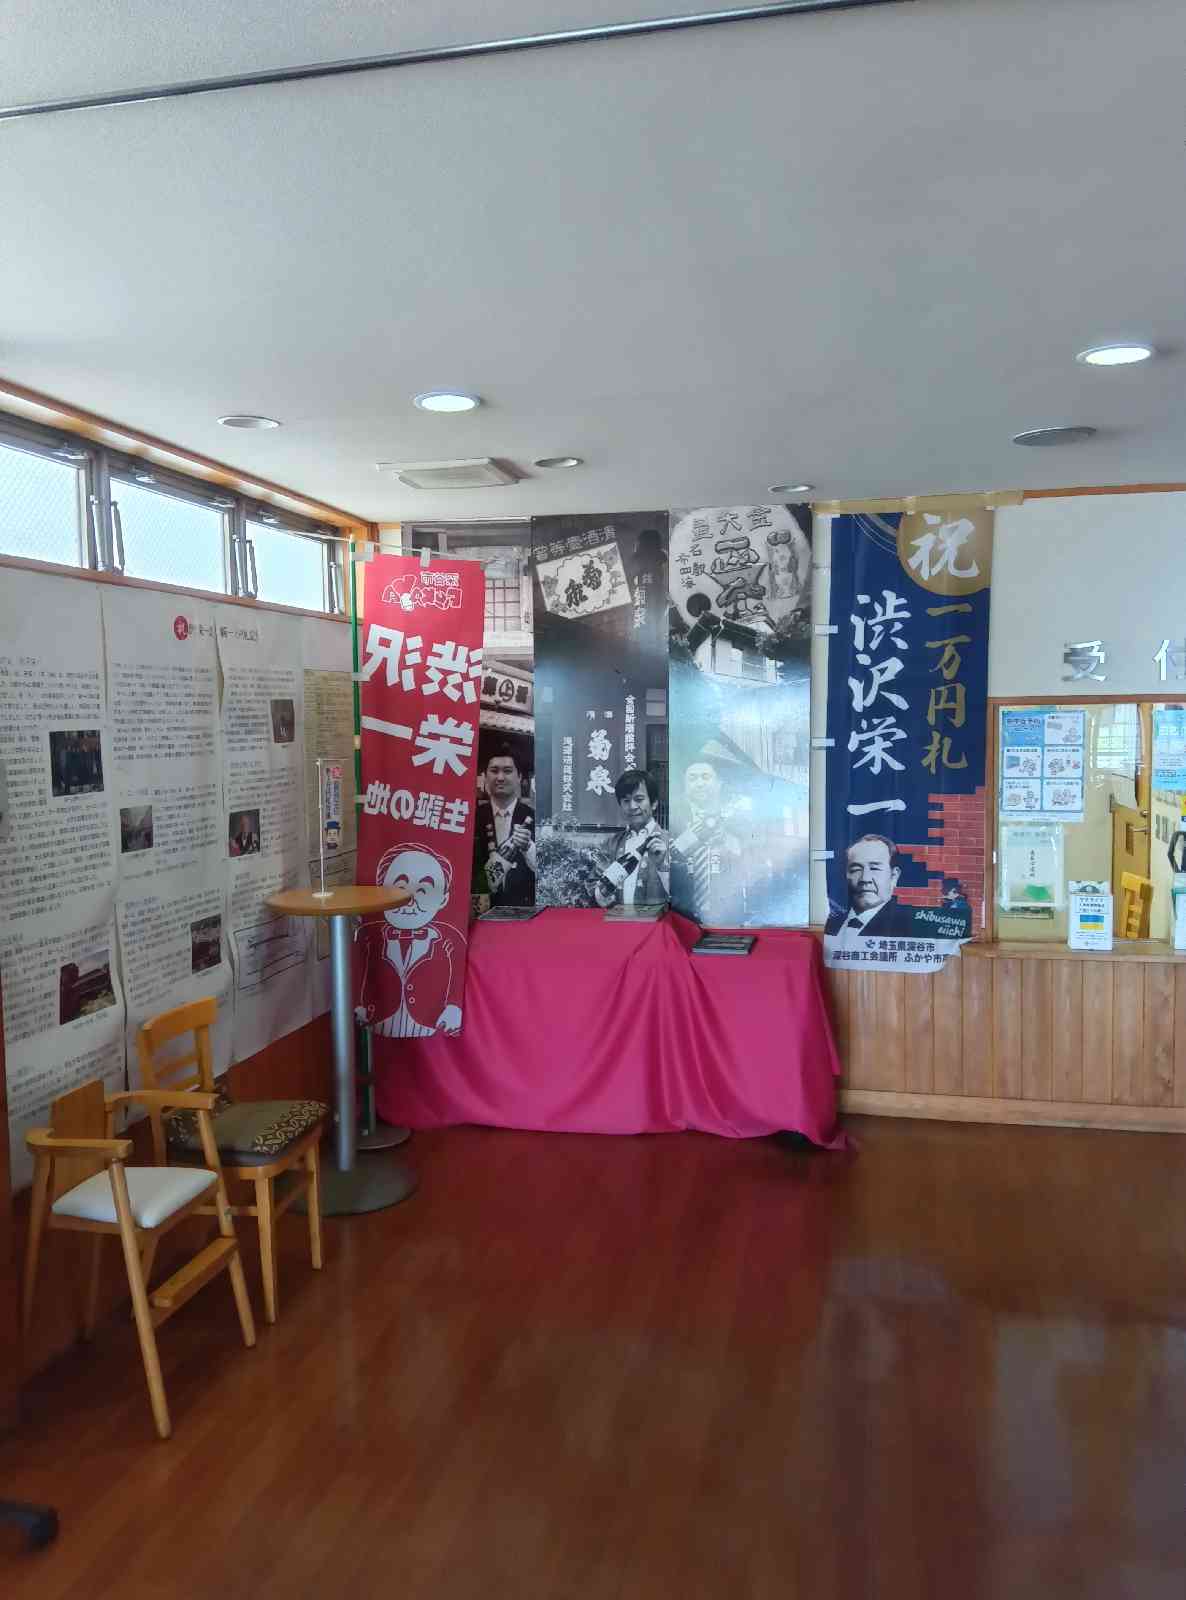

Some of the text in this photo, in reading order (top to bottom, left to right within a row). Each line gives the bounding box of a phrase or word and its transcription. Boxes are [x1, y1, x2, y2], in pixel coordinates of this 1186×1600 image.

[907, 513, 979, 579] 祝
[847, 589, 912, 816] 渋沢栄一
[920, 602, 972, 776] 一万円札
[878, 940, 935, 952] 埼玉県深谷市
